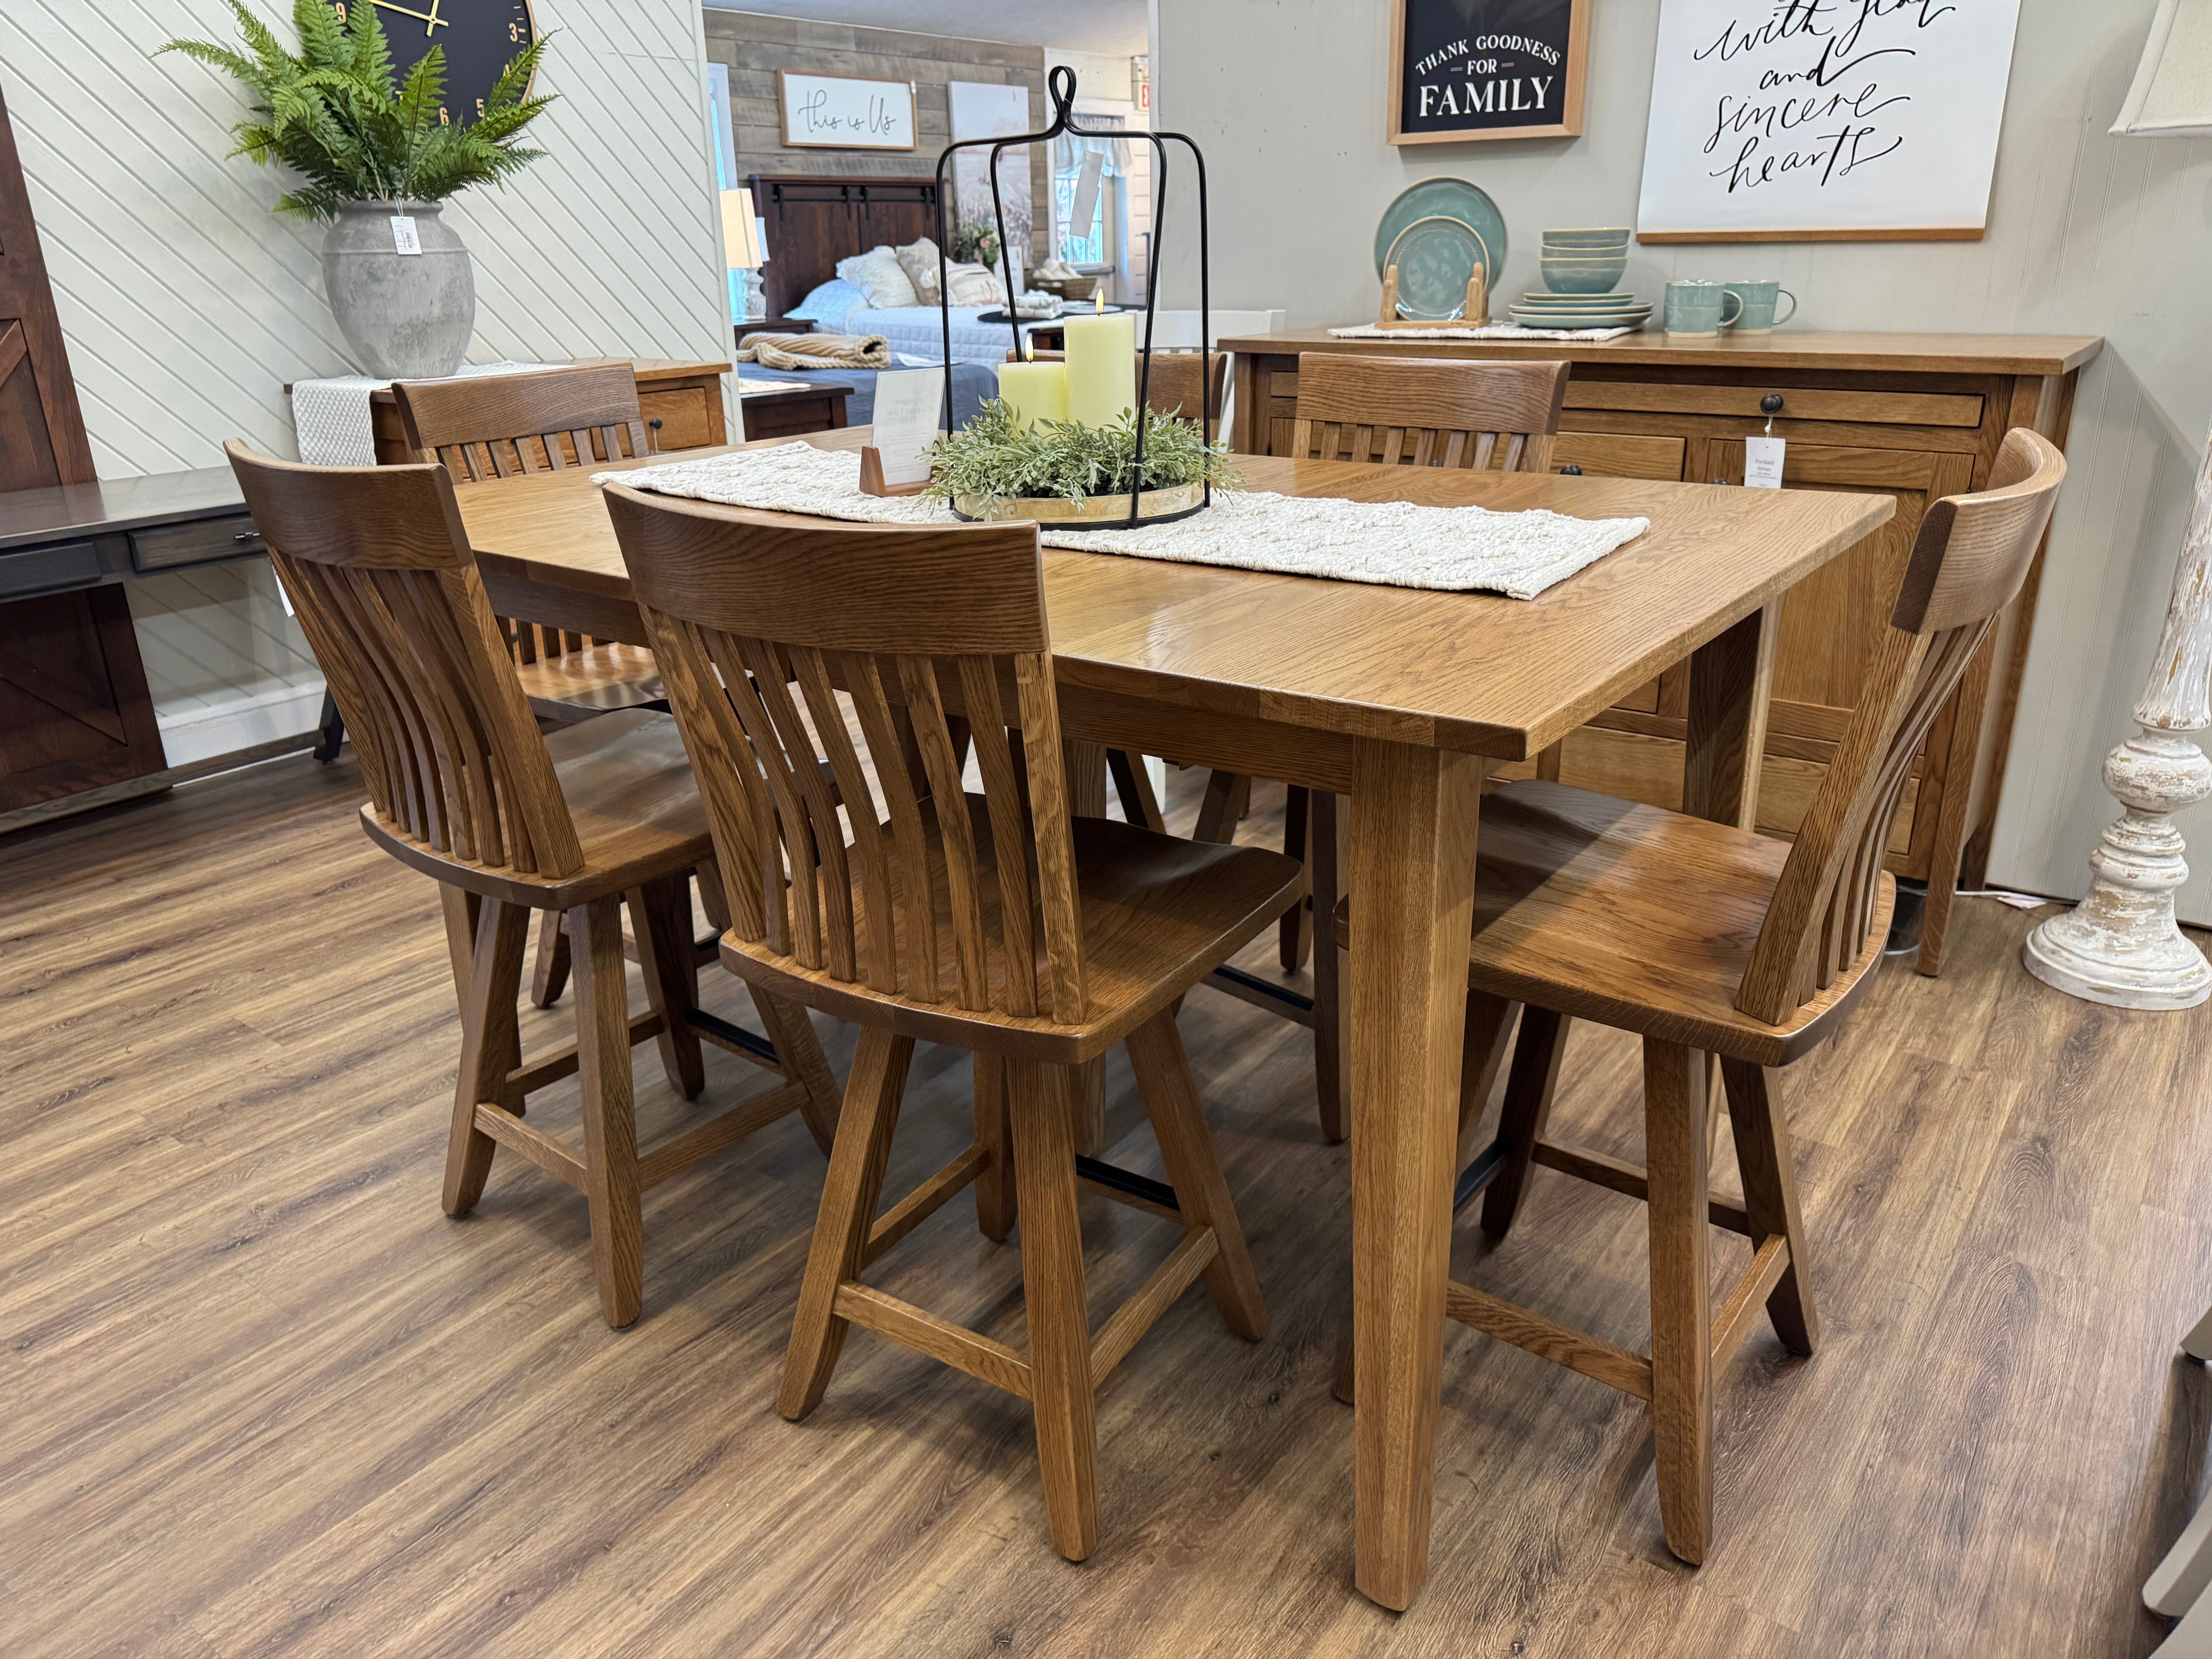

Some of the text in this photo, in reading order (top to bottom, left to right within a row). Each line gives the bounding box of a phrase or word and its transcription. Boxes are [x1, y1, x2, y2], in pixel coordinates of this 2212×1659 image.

[336, 2, 347, 24] 9
[509, 23, 518, 42] 3
[1693, 0, 1837, 61] with
[1415, 35, 1561, 76] THANK GOODNESS
[1467, 58, 1498, 75] FOR
[1760, 36, 1917, 89] and
[439, 107, 450, 126] 6
[476, 99, 484, 118] 5
[847, 116, 865, 131] is
[869, 94, 896, 136] Us
[1419, 76, 1554, 117] FAMILY
[1704, 83, 1911, 154] sincere
[1709, 125, 1903, 193] hearts
